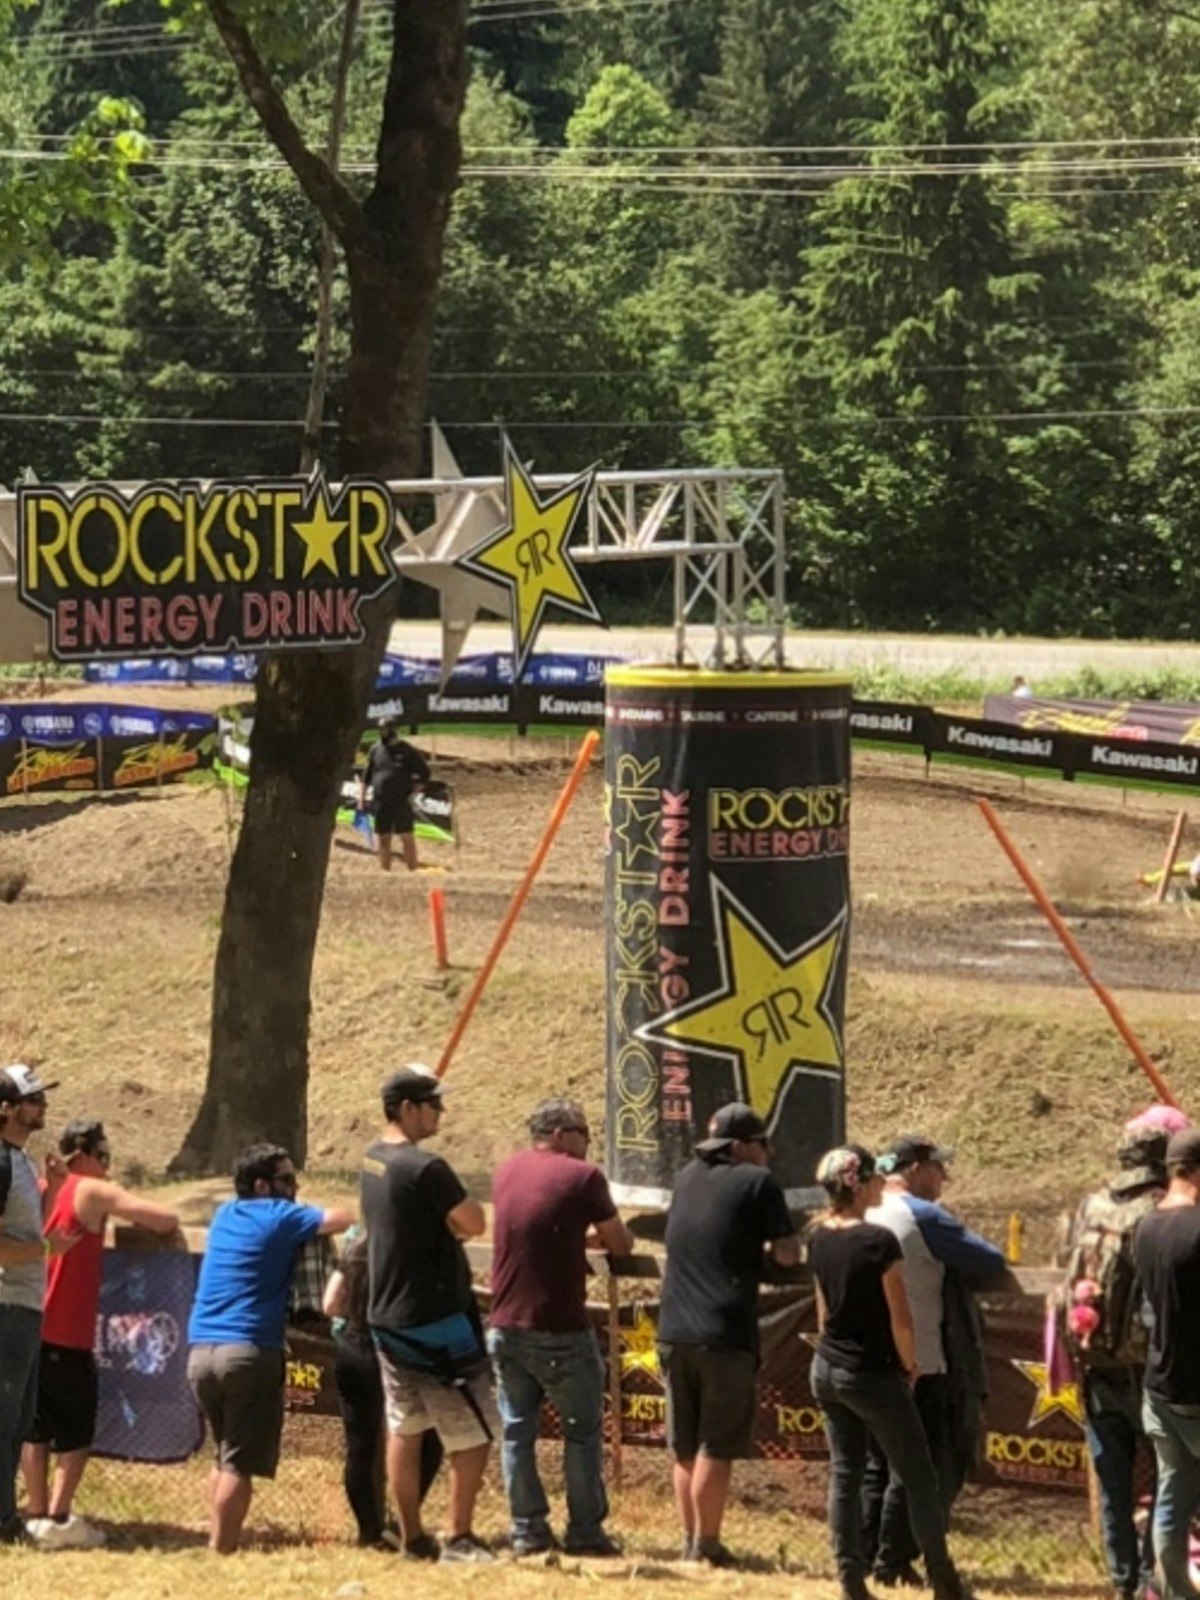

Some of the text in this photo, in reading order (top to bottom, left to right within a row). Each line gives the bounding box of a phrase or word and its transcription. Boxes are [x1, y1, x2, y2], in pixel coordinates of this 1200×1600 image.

[56, 587, 359, 647] ENERGY DRINK
[428, 694, 509, 713] Kawasaki
[948, 725, 1053, 757] Kawasaki
[1091, 745, 1199, 775] Kawasaki
[715, 829, 822, 856] ENERGY
[659, 788, 692, 1122] ENGY DRINK
